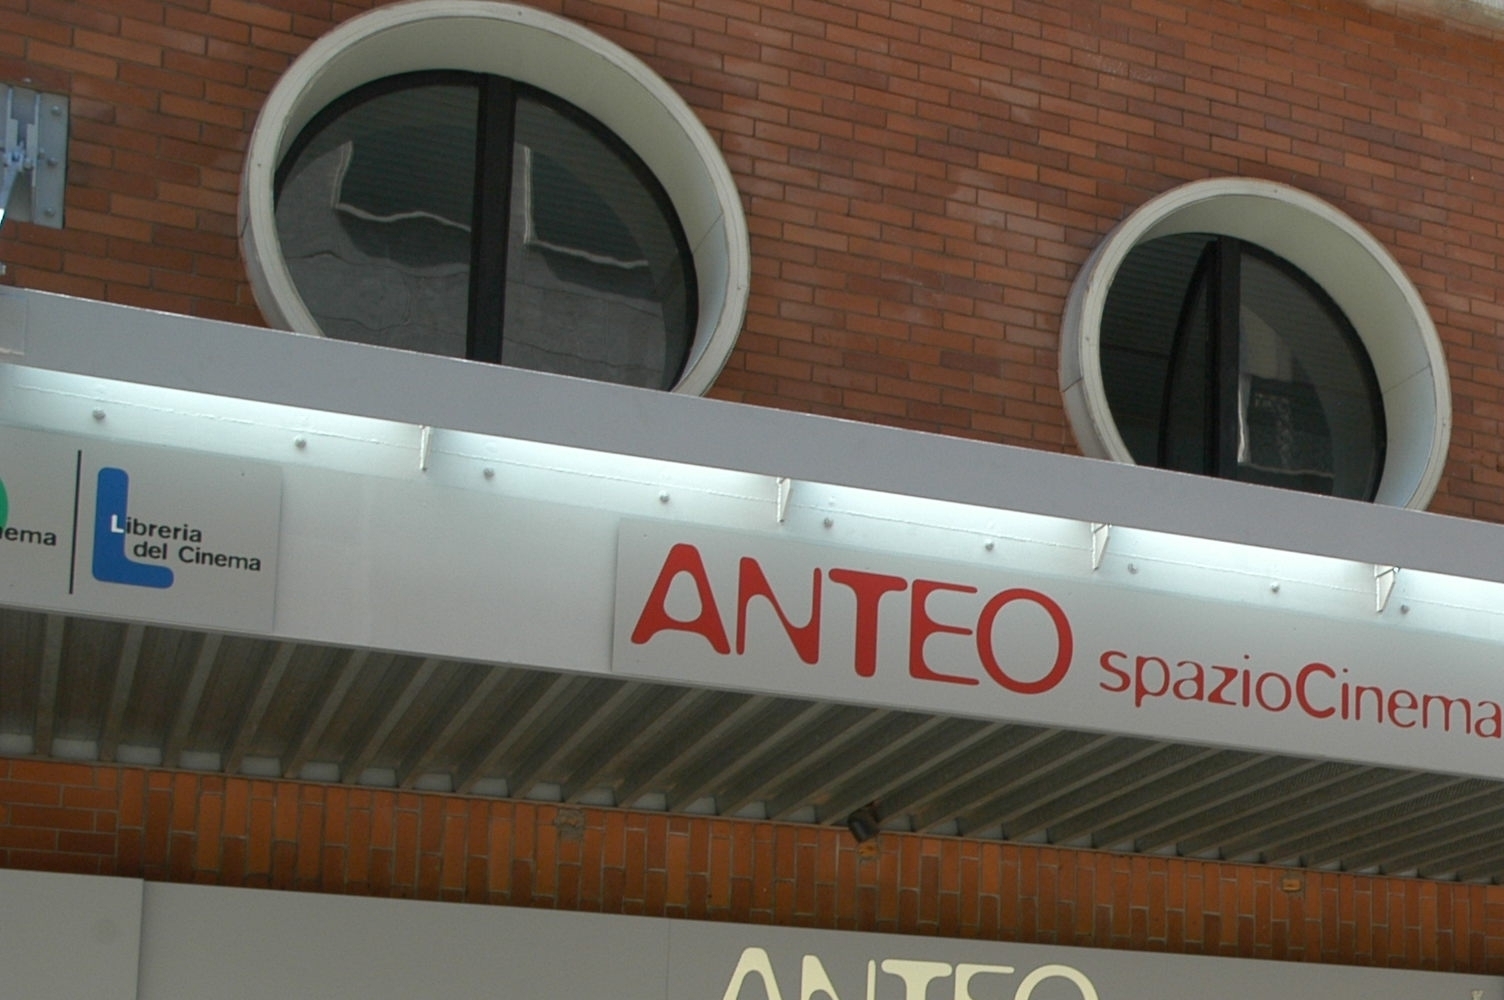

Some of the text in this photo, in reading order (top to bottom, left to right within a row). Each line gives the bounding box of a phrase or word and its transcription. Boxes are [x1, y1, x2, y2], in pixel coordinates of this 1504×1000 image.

[110, 514, 202, 543] Libreria
[133, 541, 261, 571] del Cinema
[631, 543, 1502, 739] ANTEO spazioCinema
